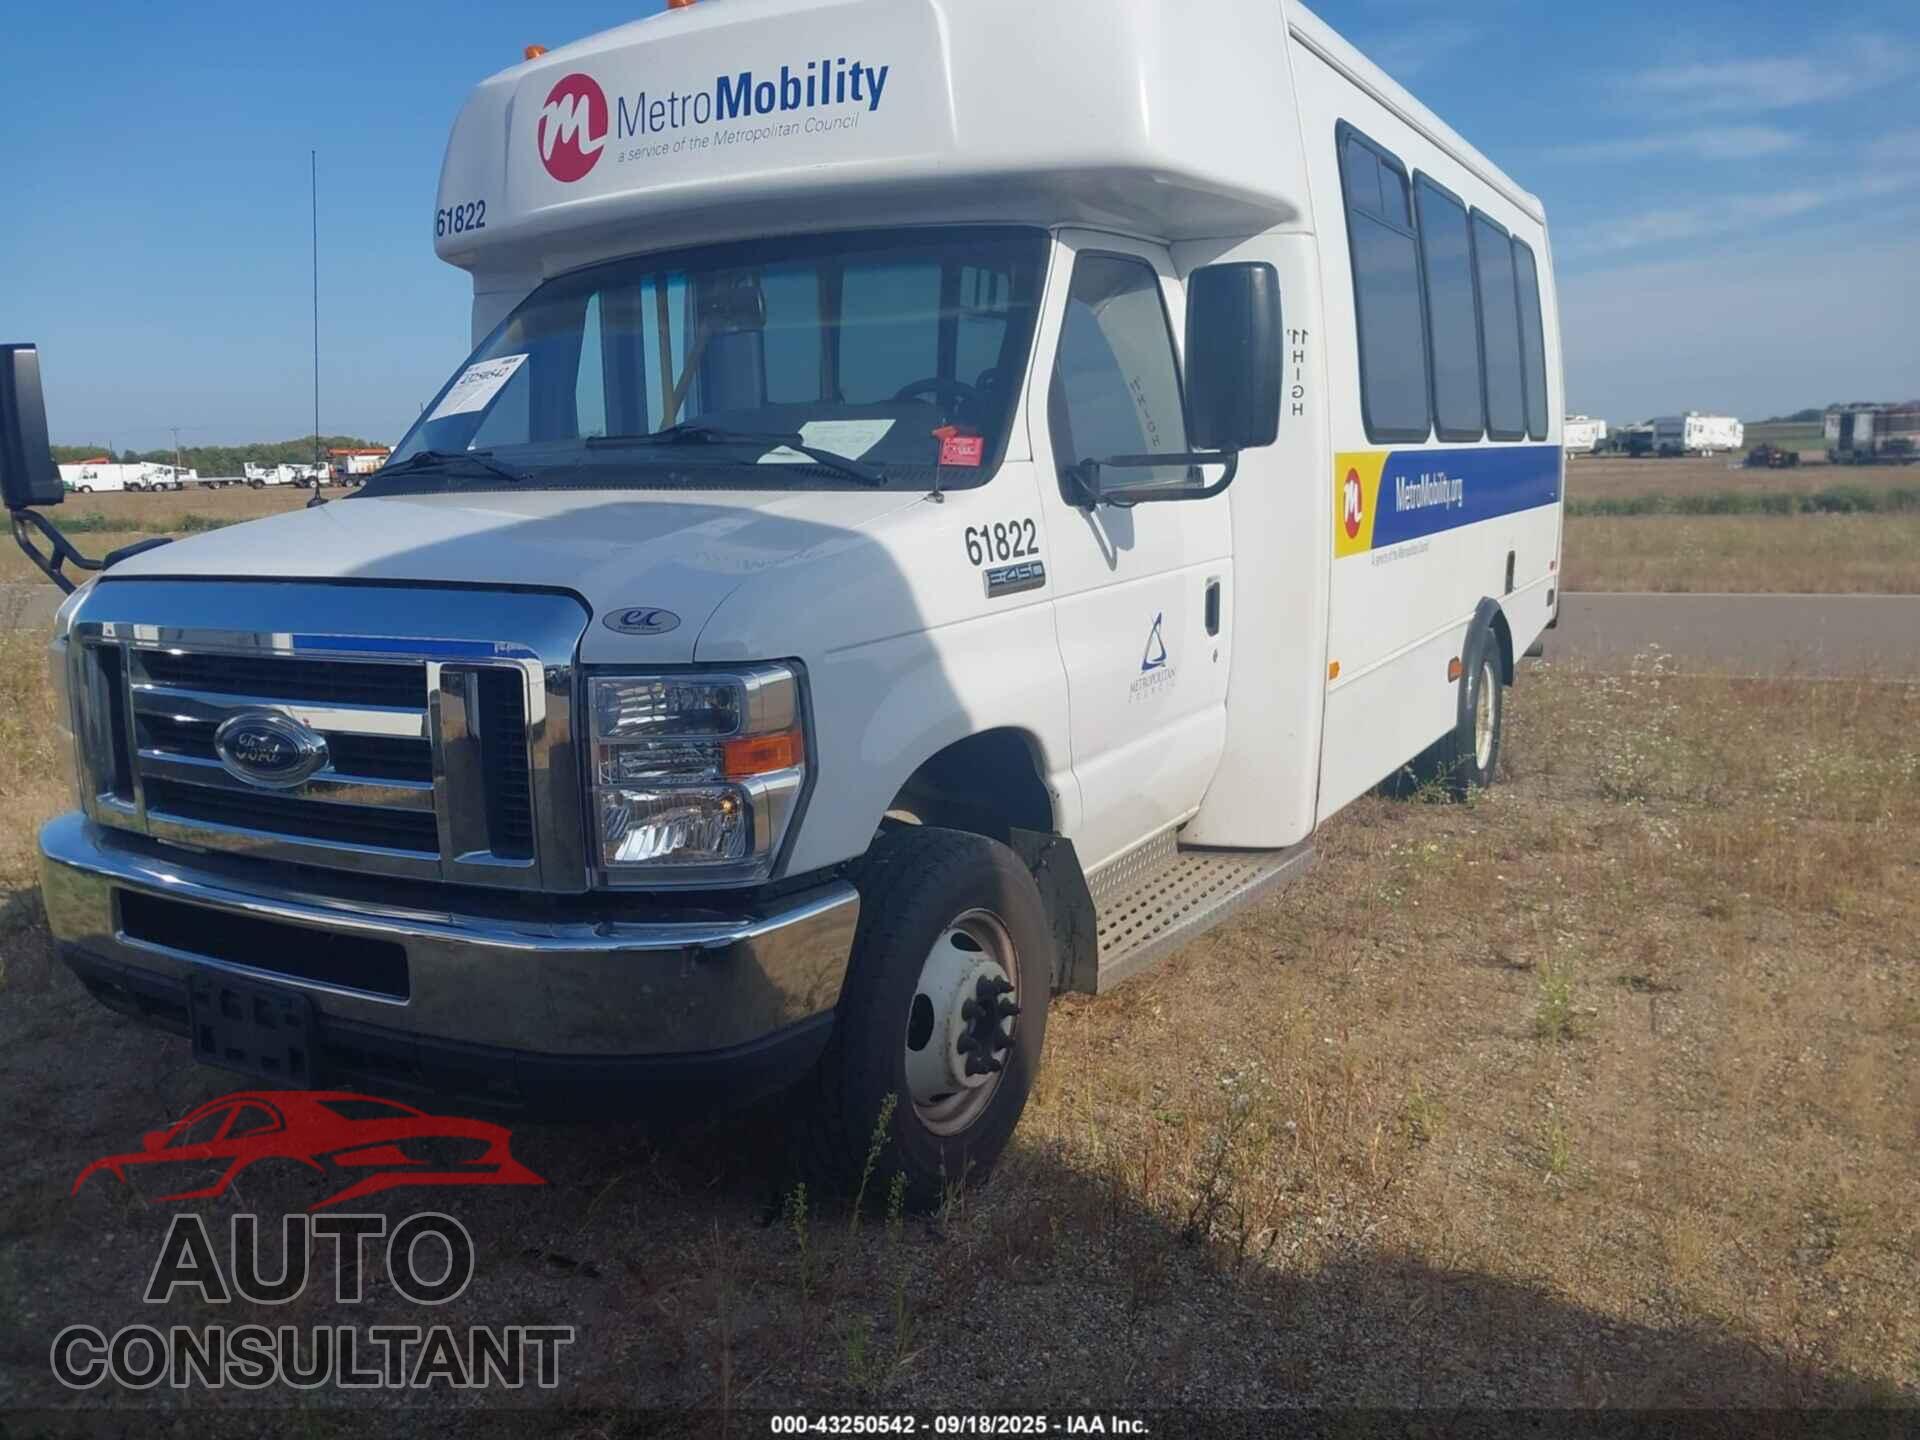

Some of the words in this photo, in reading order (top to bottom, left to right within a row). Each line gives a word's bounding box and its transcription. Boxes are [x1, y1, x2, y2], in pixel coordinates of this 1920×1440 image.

[617, 57, 889, 139] MetroMobility
[617, 152, 625, 163] a
[627, 143, 669, 161] service
[672, 137, 687, 152] of
[689, 135, 710, 149] the
[713, 122, 800, 147] Metropolitan
[804, 112, 860, 134] Council
[436, 199, 486, 237] 61822
[1396, 472, 1463, 512] MetroMobility.org
[965, 518, 1039, 566] 61822
